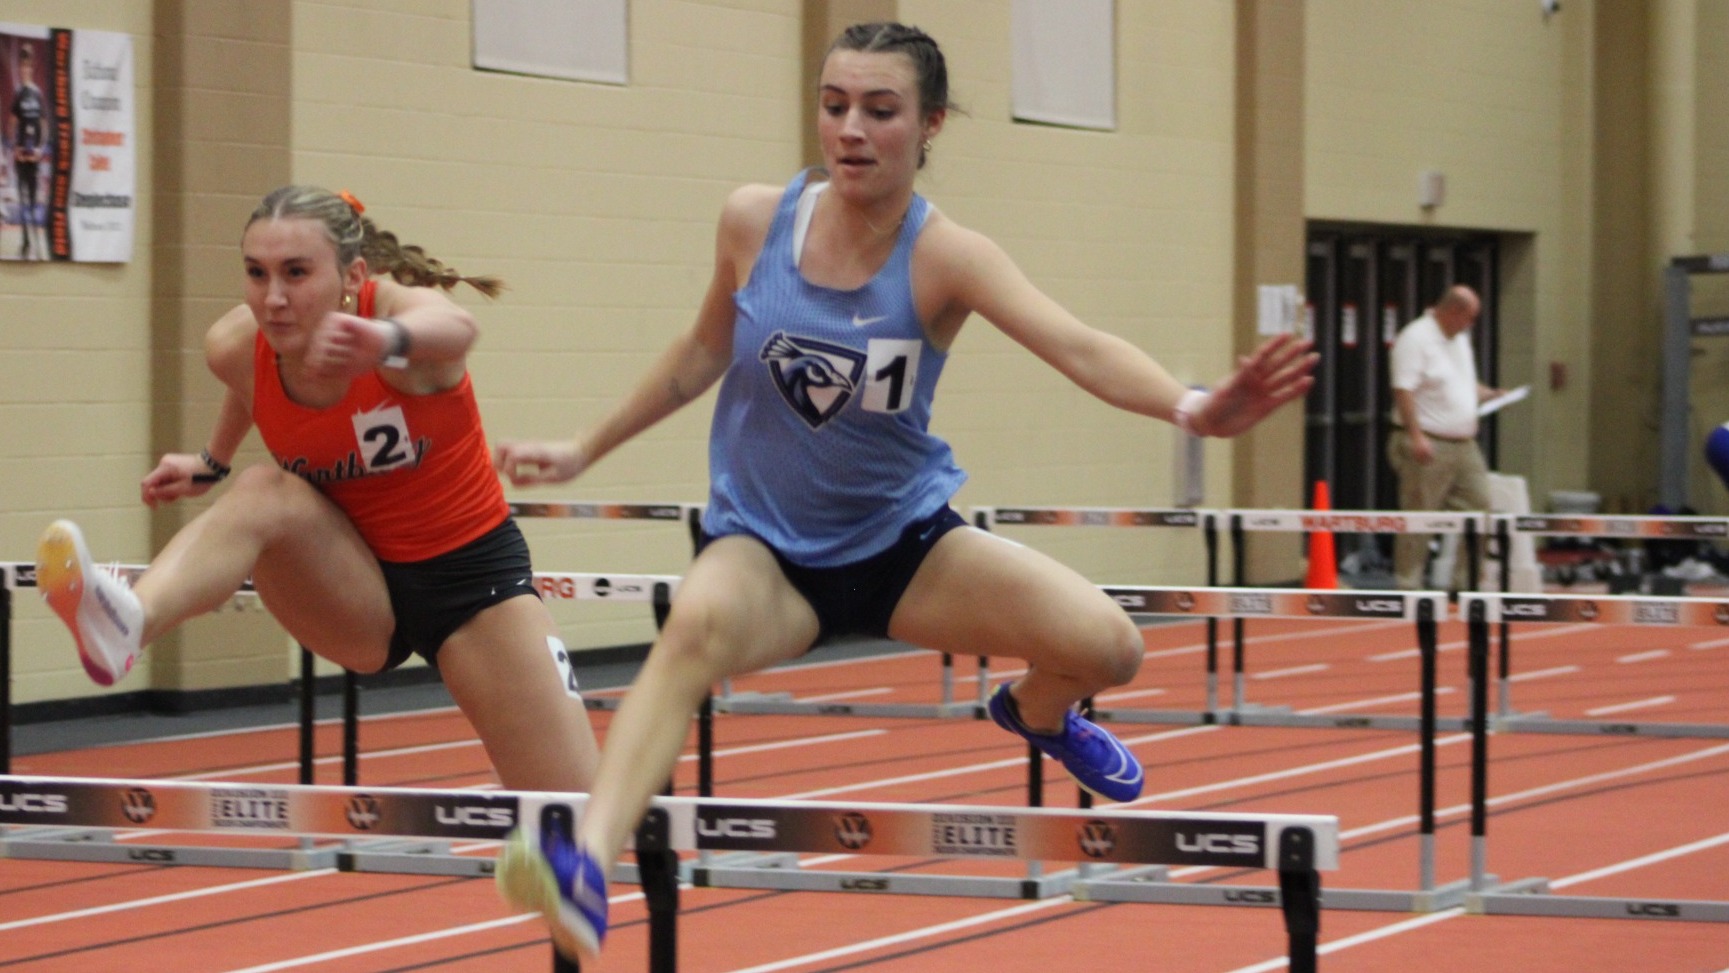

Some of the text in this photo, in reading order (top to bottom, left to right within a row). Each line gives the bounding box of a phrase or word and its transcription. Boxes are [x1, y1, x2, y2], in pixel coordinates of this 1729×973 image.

[875, 355, 907, 410] 1
[363, 424, 407, 468] 2
[222, 799, 288, 819] ELITE
[435, 805, 513, 826] UCS
[698, 818, 777, 839] UCS
[944, 825, 1016, 846] ELITE
[1175, 832, 1259, 854] UCS
[839, 879, 890, 891] UCS
